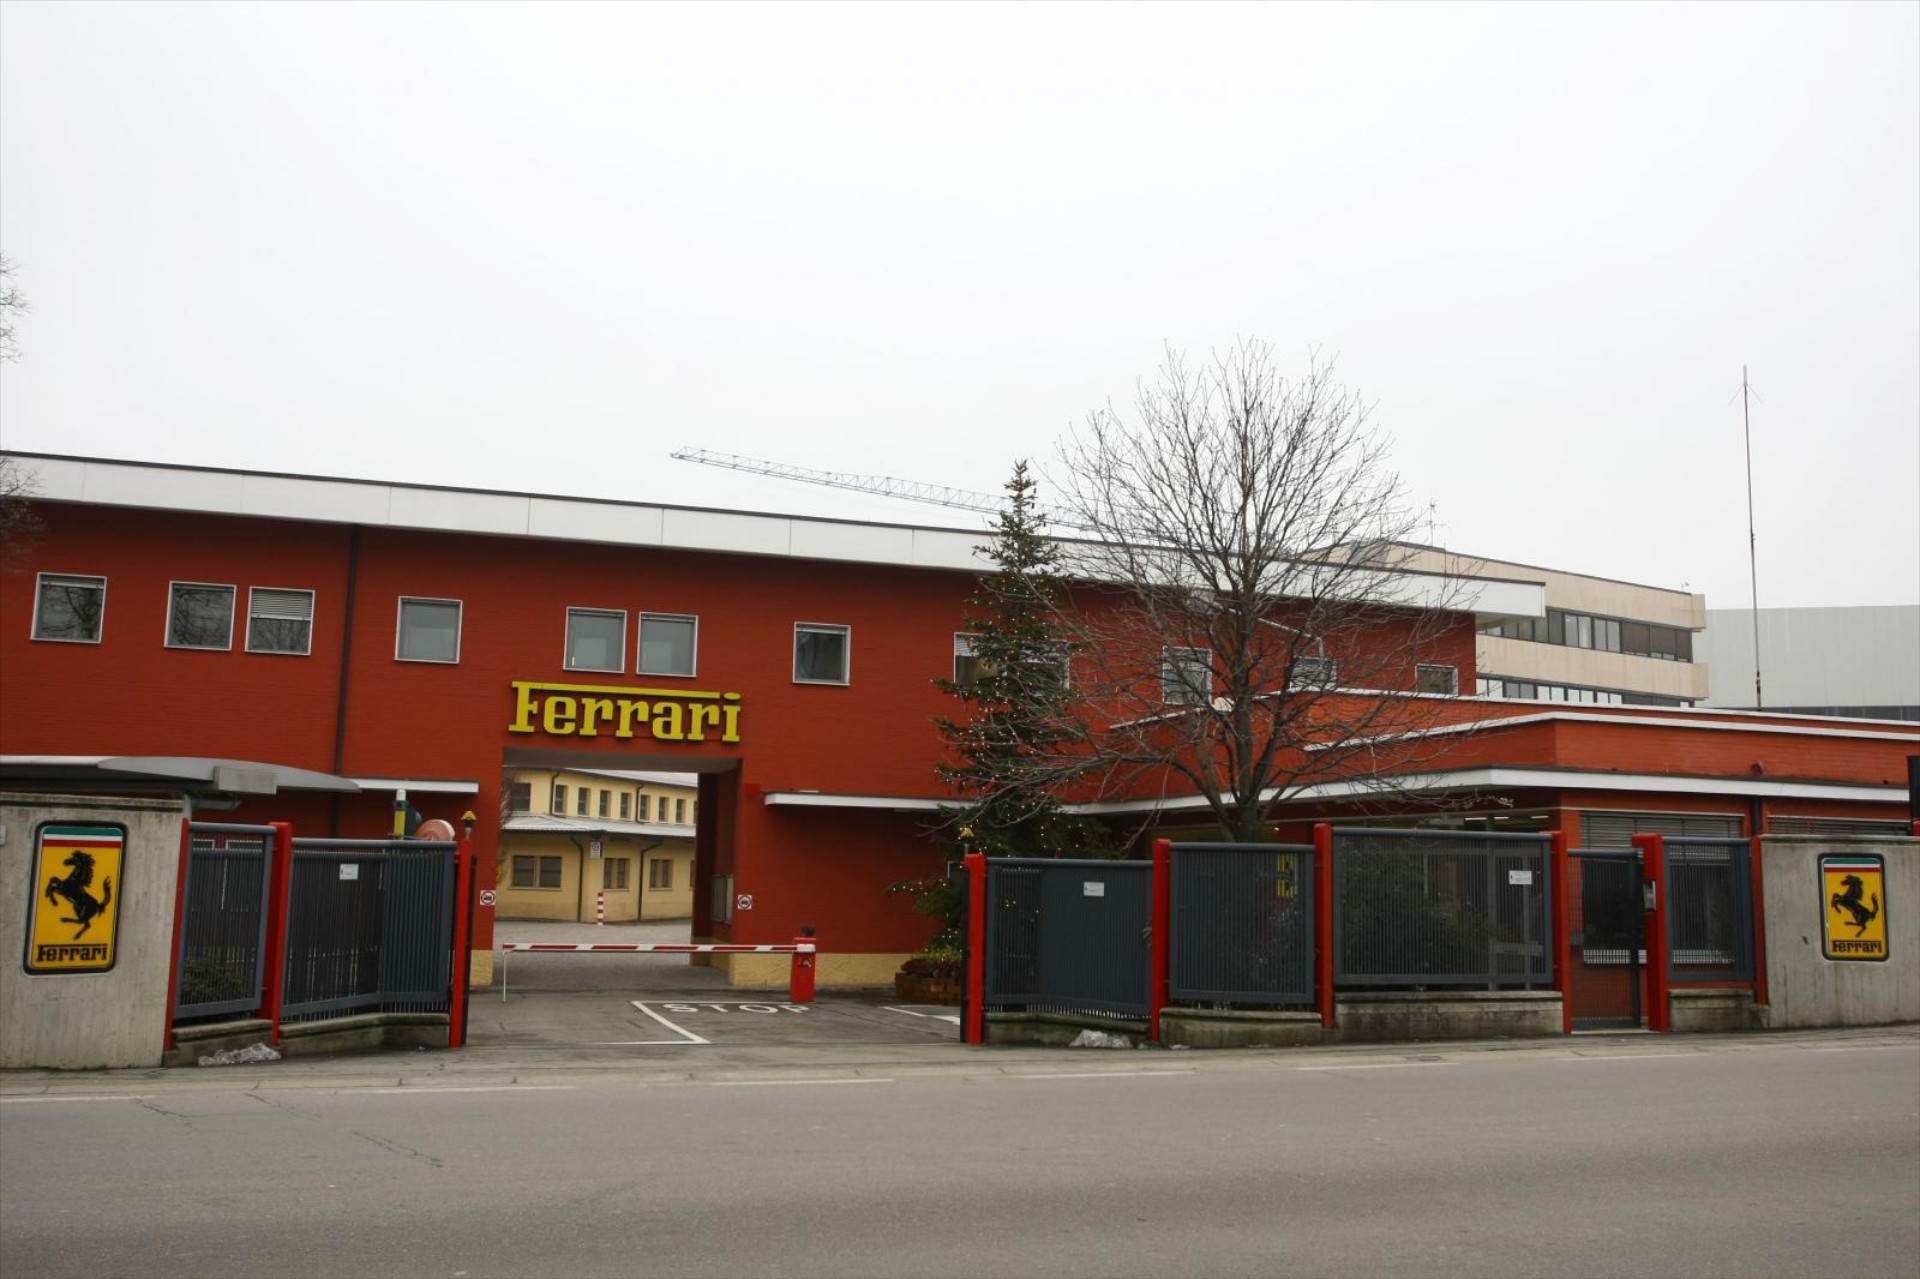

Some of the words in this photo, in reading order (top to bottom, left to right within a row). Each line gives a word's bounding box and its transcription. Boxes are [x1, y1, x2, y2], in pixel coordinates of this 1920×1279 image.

[508, 681, 741, 742] Ferrari
[36, 943, 108, 962] Ferrari
[1831, 940, 1882, 953] Ferrari
[663, 1003, 810, 1014] STOP
